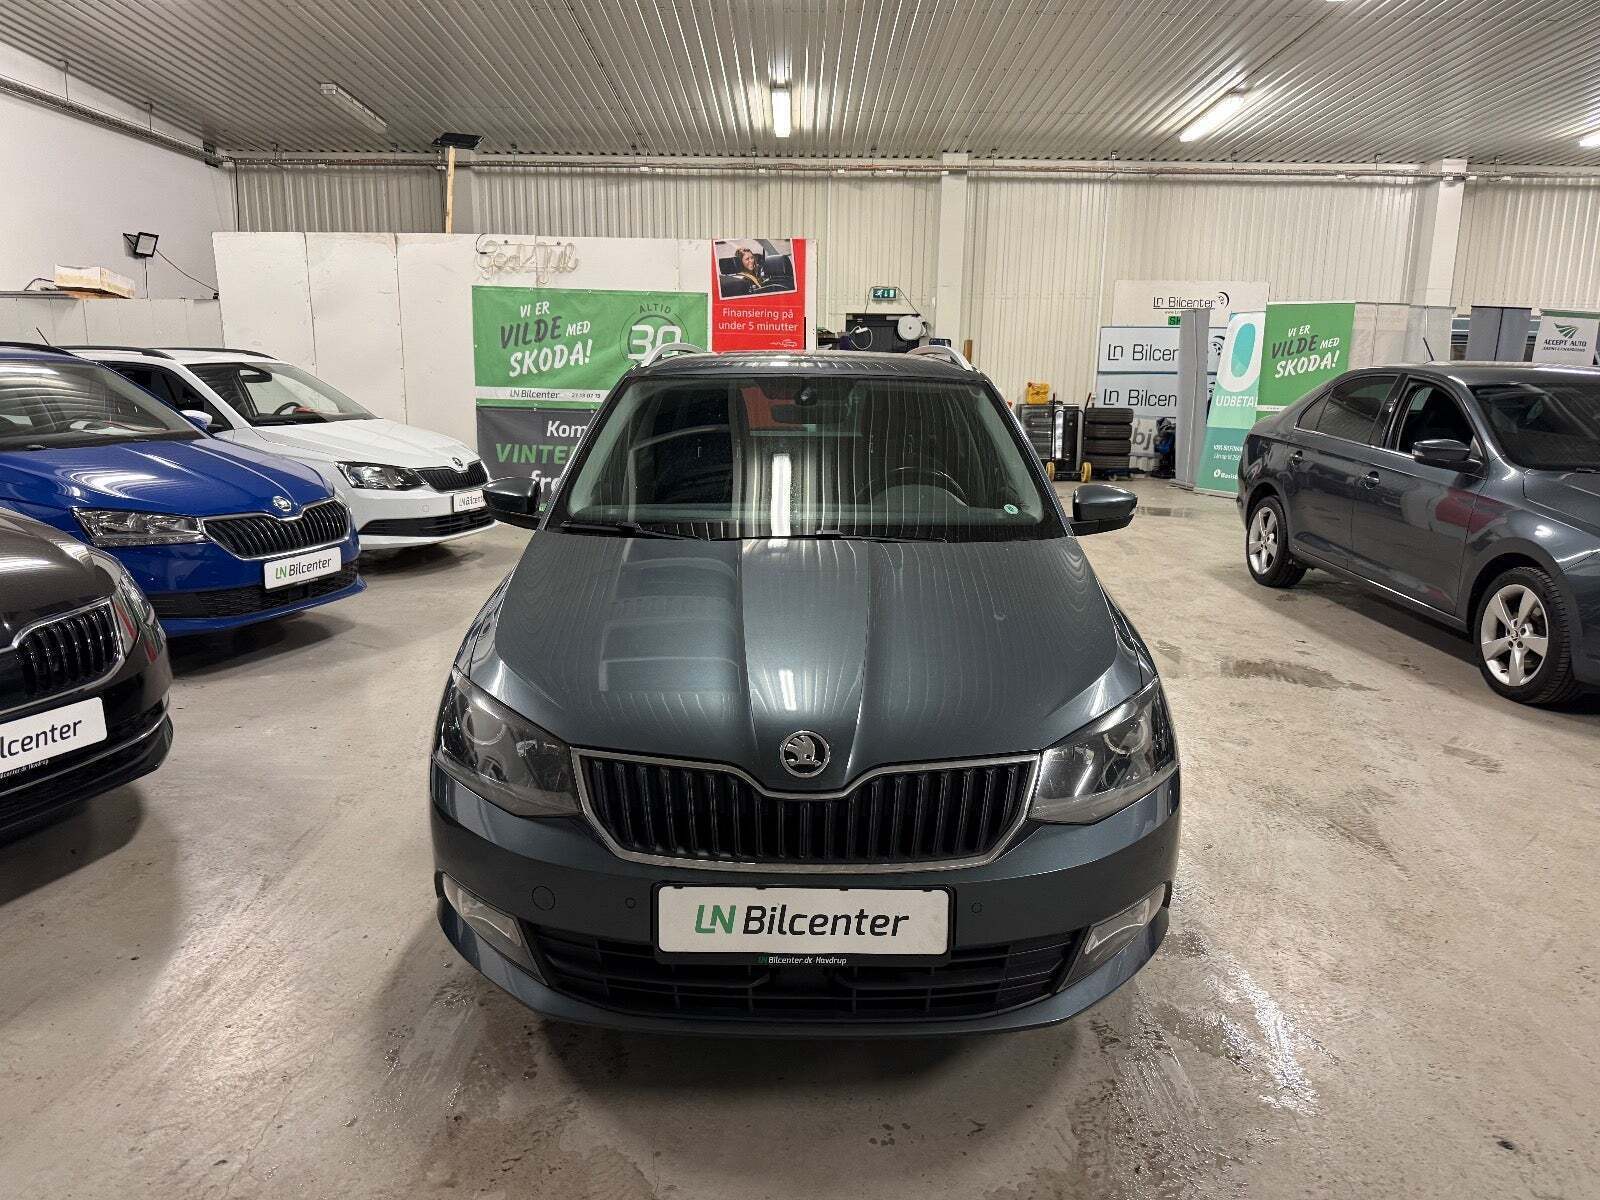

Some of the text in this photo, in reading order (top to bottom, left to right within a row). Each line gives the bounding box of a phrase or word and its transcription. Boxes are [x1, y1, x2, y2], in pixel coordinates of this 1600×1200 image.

[520, 301, 551, 318] VI ER
[639, 303, 672, 314] ALTID
[1168, 296, 1216, 308] Bilcenter
[723, 307, 794, 320] Finansiering på
[500, 314, 591, 349] VILDE MED
[718, 319, 799, 332] under 5 minutter
[1288, 325, 1310, 337] VI ER
[1271, 334, 1340, 360] VILDE MED
[508, 339, 593, 379] SKODA!
[1275, 350, 1339, 378] SKODA!
[521, 389, 560, 399] Bilcenter
[1128, 388, 1177, 407] Bilcen
[495, 443, 576, 465] VINTE
[275, 557, 331, 580] LN Bilcenter
[694, 904, 910, 937] LN Bilcenter
[815, 956, 847, 966] Havdrup
